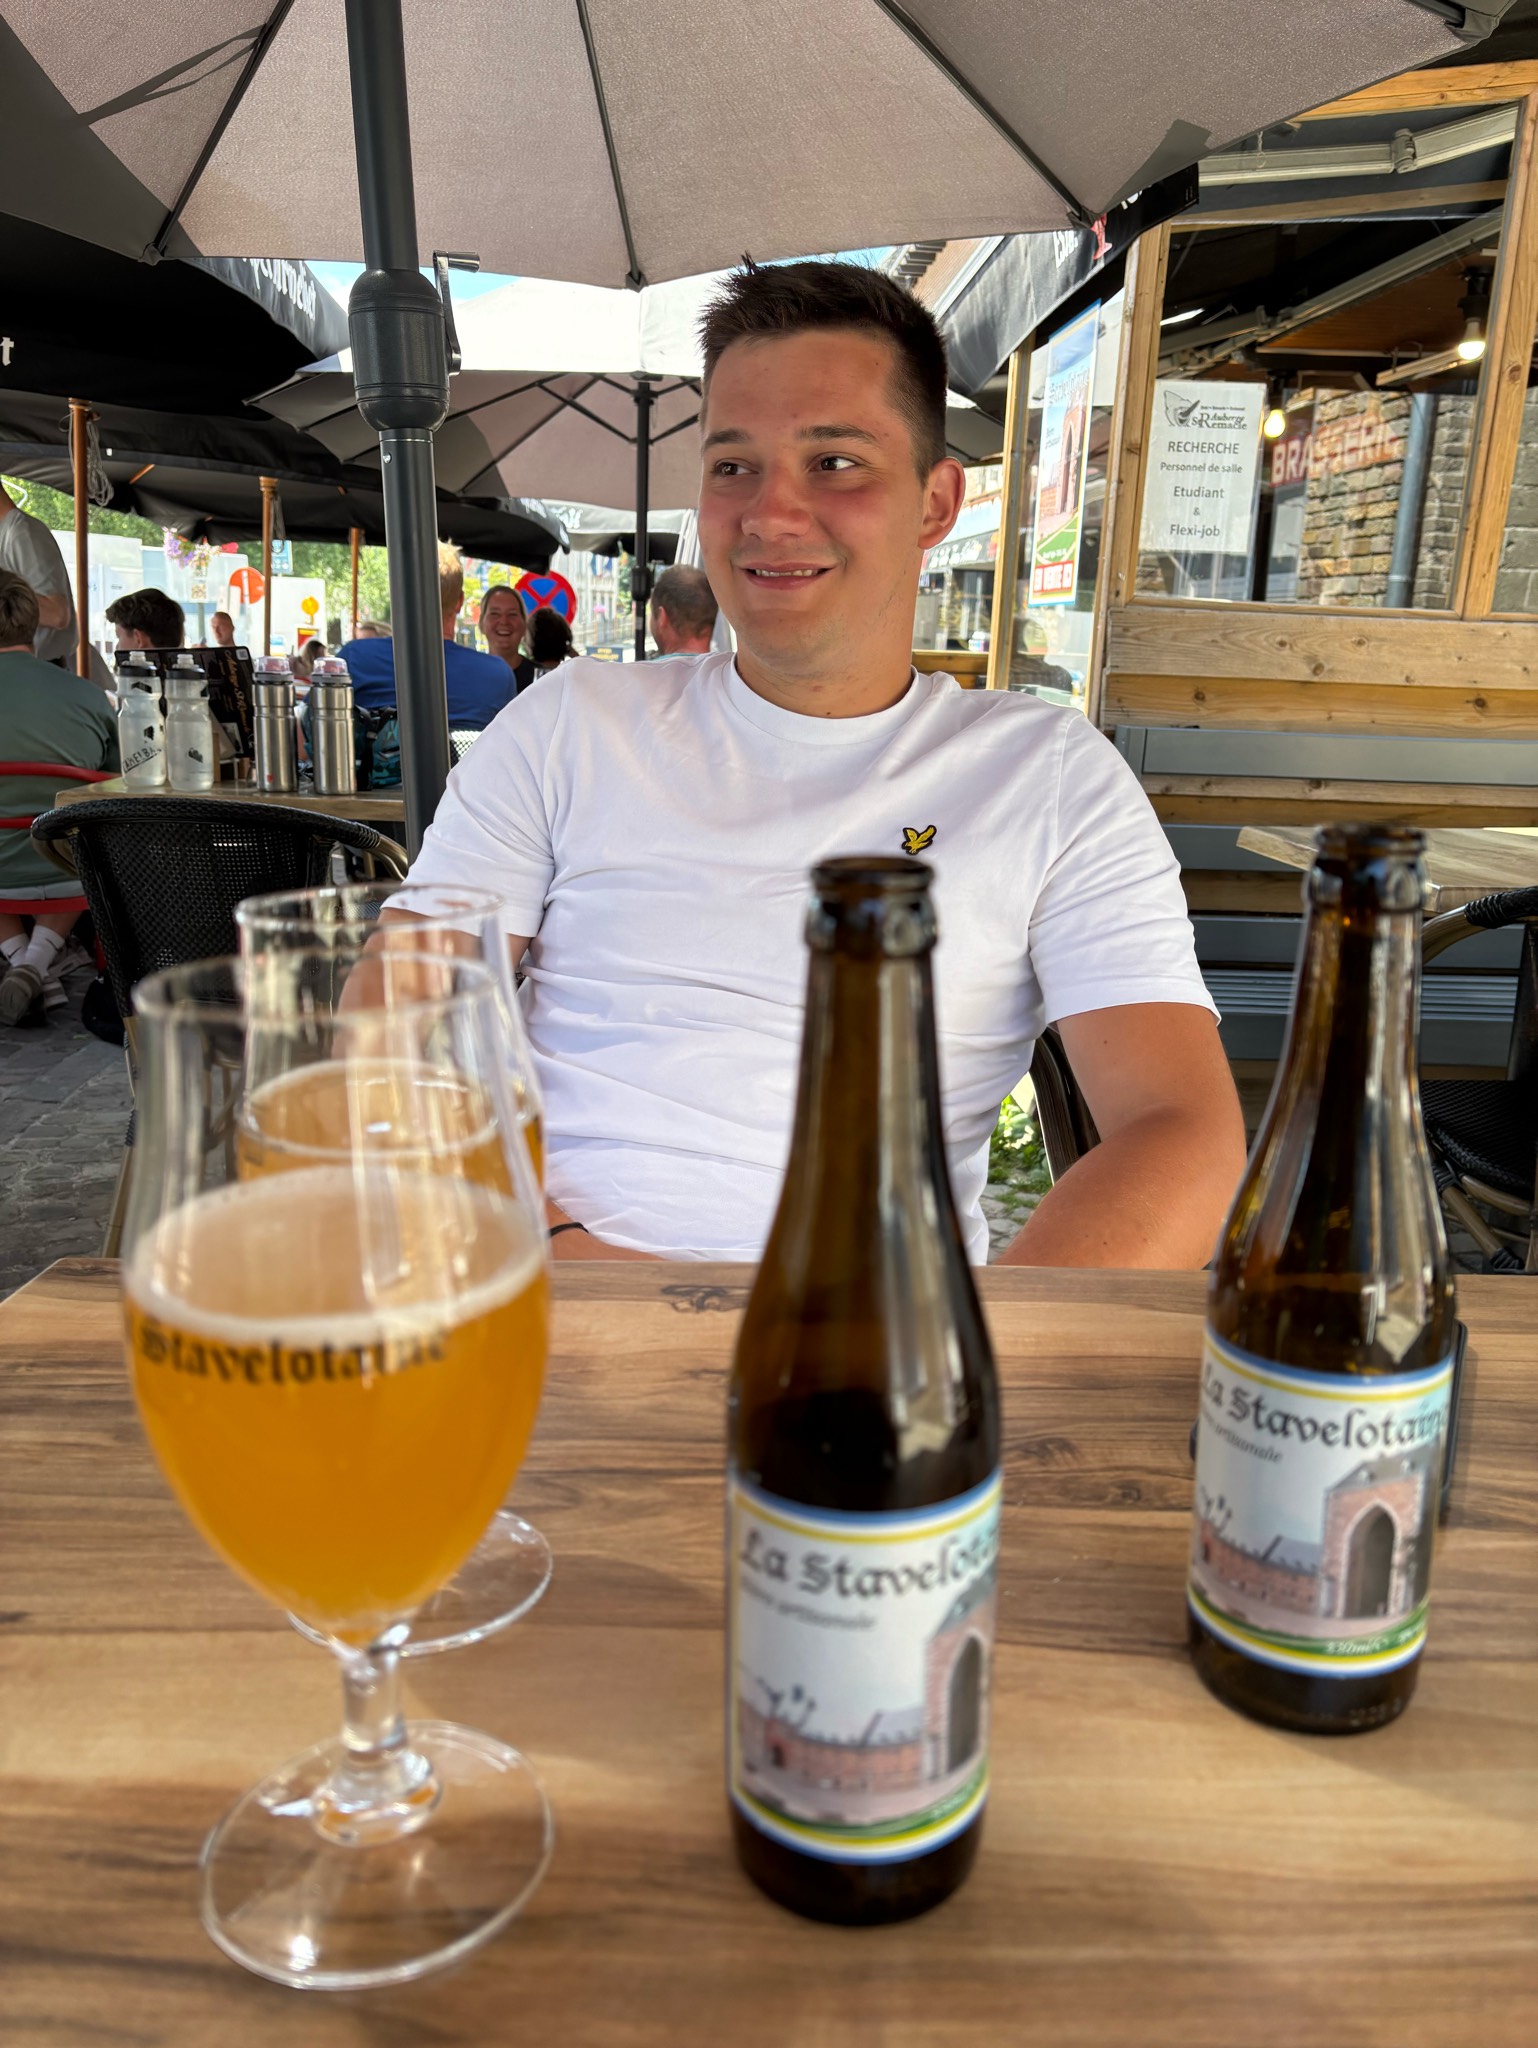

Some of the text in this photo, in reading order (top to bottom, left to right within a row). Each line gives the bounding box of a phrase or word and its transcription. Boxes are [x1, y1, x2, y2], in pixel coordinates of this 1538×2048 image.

[1168, 441, 1239, 454] RECHERCHE
[1160, 462, 1243, 473] Personnel de salle
[1173, 486, 1225, 499] Etudiant
[1193, 507, 1200, 516] &
[1169, 524, 1221, 539] Flexi-job
